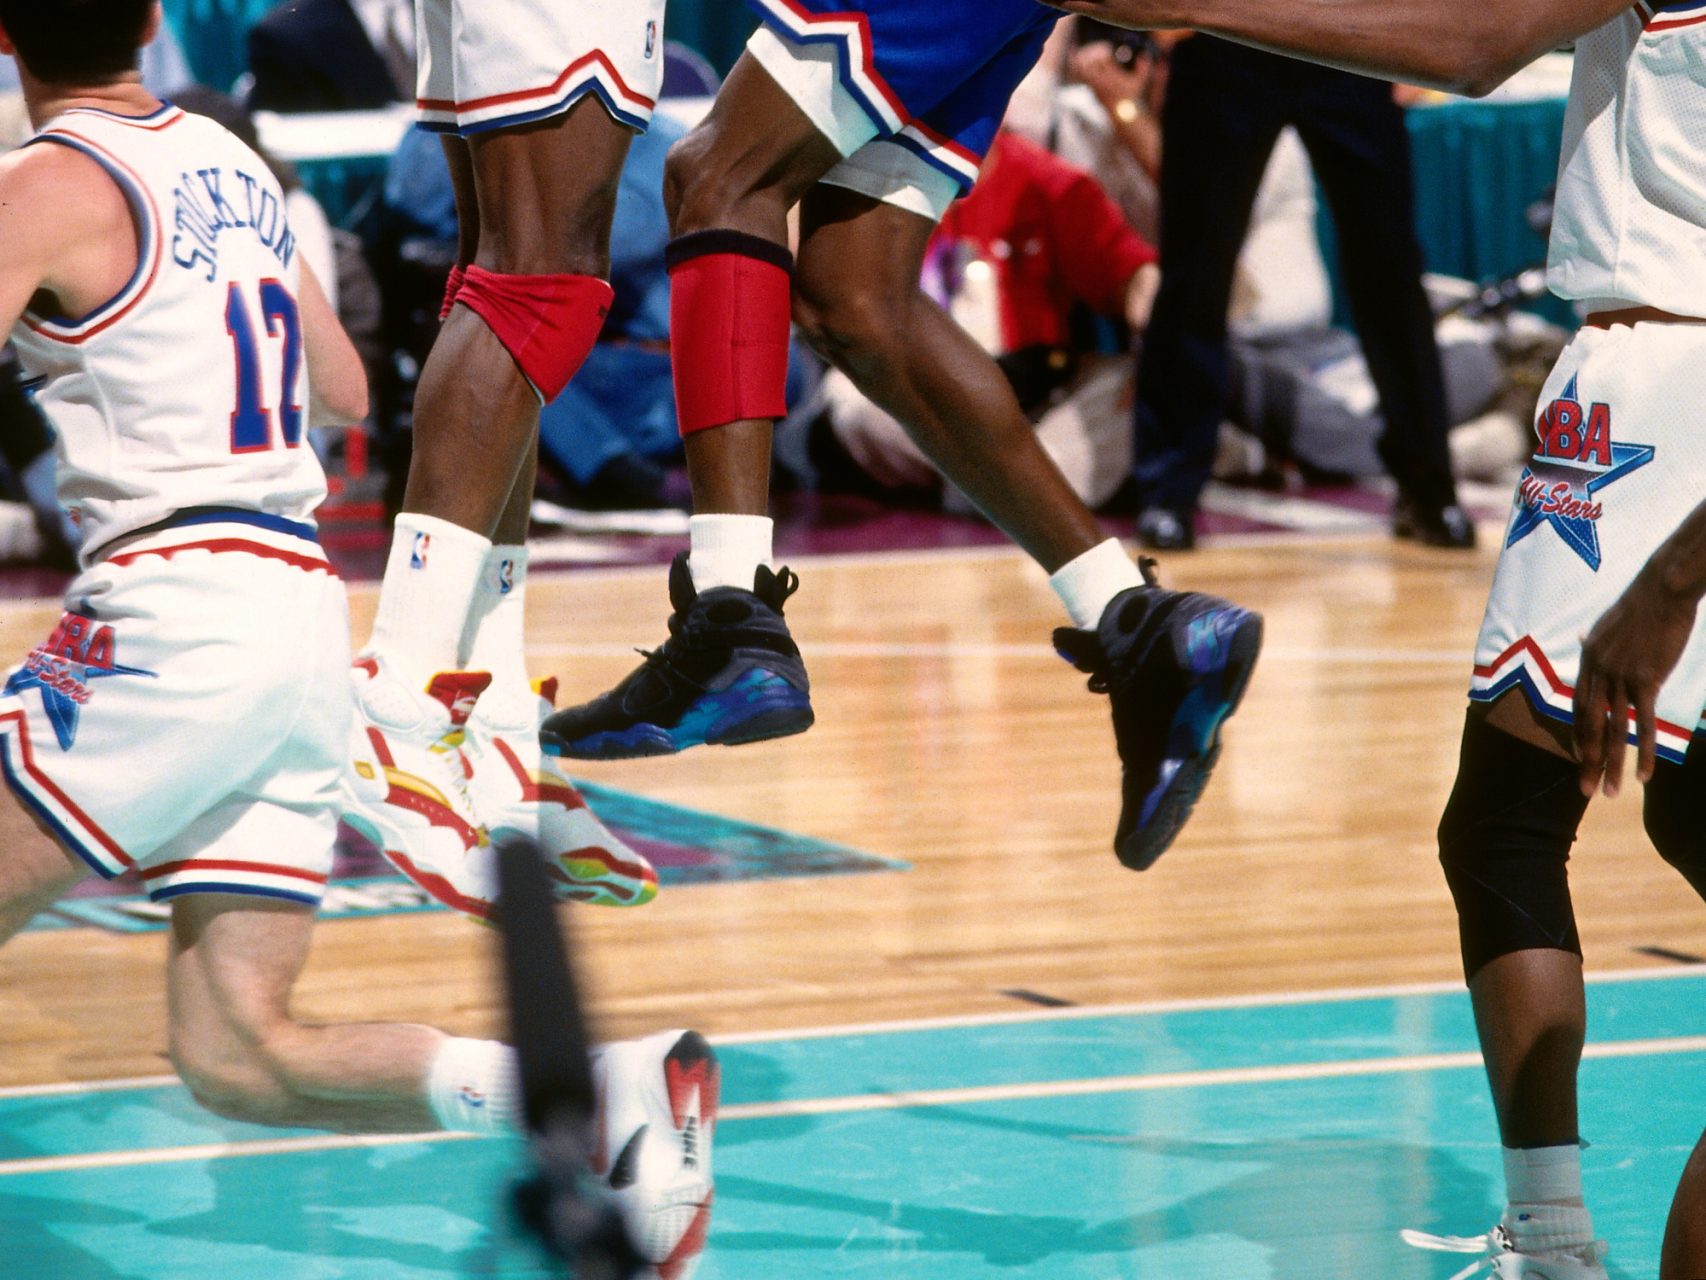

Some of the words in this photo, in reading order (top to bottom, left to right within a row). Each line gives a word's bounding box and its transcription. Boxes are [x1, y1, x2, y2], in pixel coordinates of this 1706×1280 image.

[172, 167, 296, 283] STOCKTON
[224, 277, 304, 455] 12
[1516, 475, 1604, 520] All-Stars
